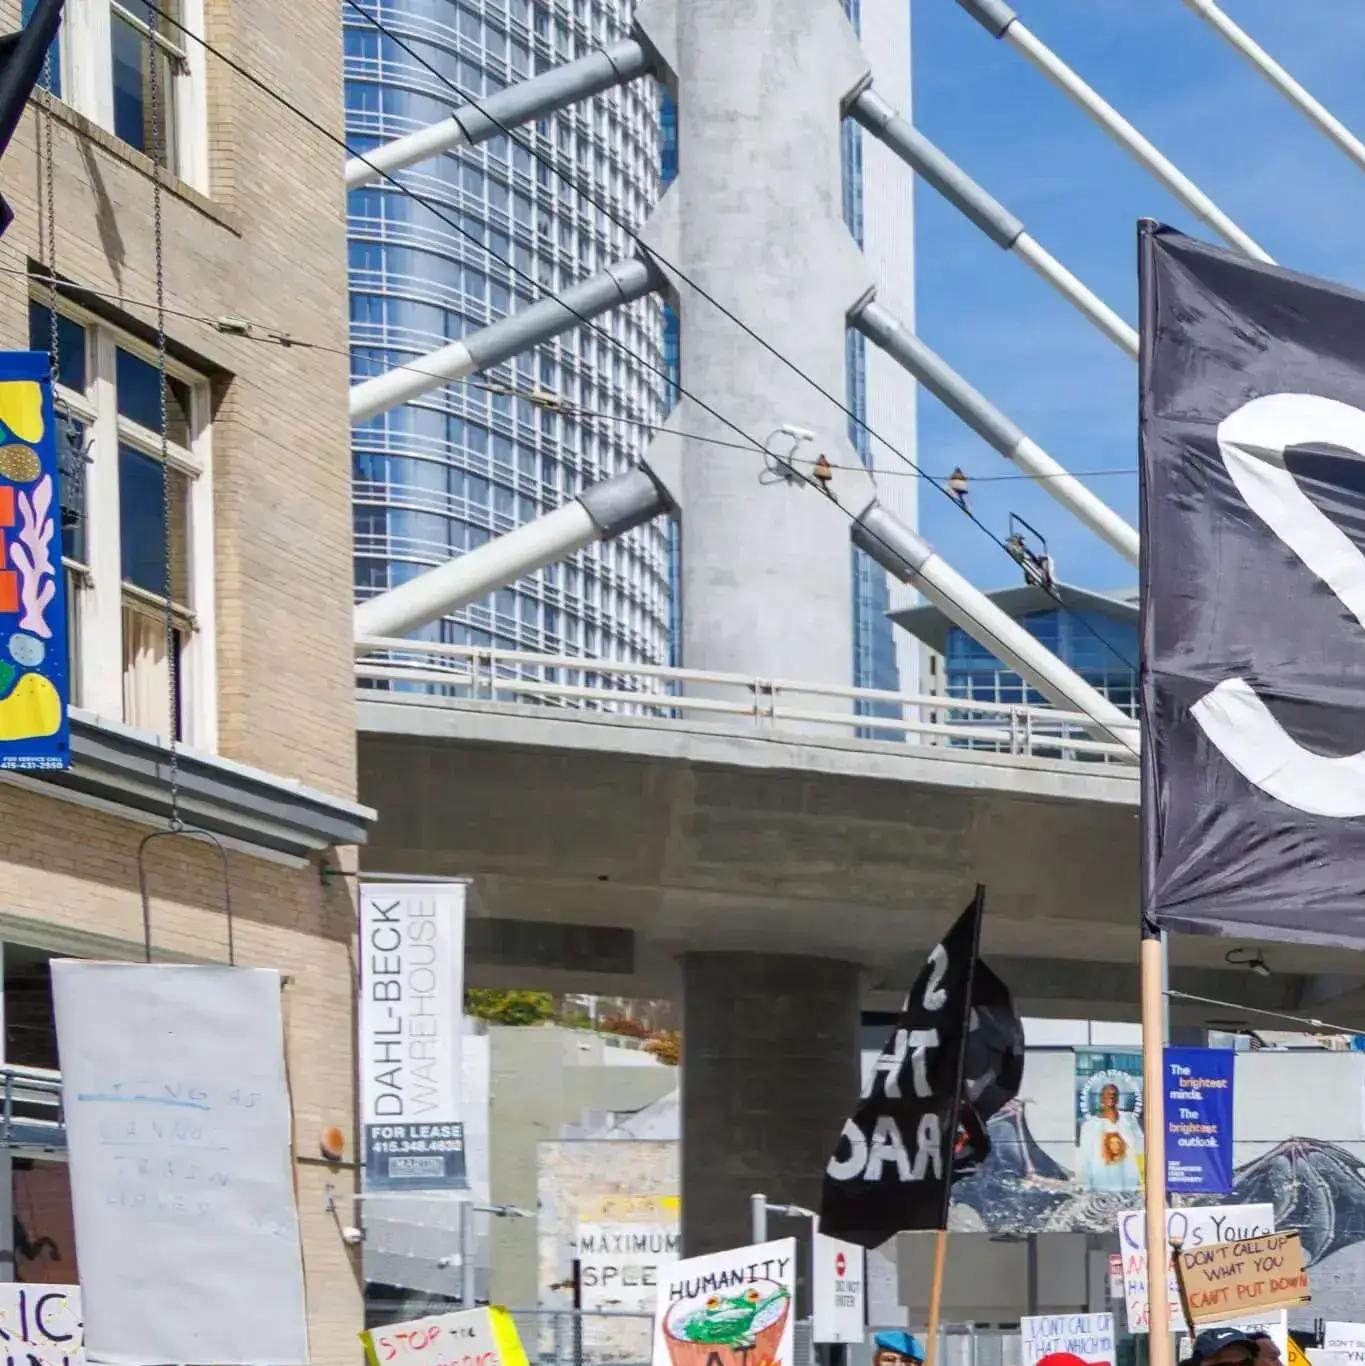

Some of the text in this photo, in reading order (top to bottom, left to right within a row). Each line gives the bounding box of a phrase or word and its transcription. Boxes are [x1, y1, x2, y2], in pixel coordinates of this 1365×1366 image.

[371, 901, 403, 1116] DAHL-BECK
[406, 897, 438, 1115] WAREHOUSE
[1170, 1064, 1191, 1075] The
[1179, 1077, 1228, 1089] brightest
[1179, 1108, 1199, 1119] The
[372, 1125, 463, 1138] FOR LEASE
[580, 1234, 681, 1254] MAXIMUM
[1184, 1247, 1228, 1270] DON'T
[1233, 1241, 1261, 1257] CALL
[1267, 1237, 1289, 1251] UP
[583, 1266, 656, 1287] SPEE
[669, 1257, 790, 1301] HUMANITY
[1203, 1256, 1284, 1282] WHAT YOU
[1237, 1281, 1265, 1297] PUT
[1270, 1275, 1308, 1291] DOWN
[0, 1290, 73, 1342] IC
[379, 1326, 441, 1361] STOP
